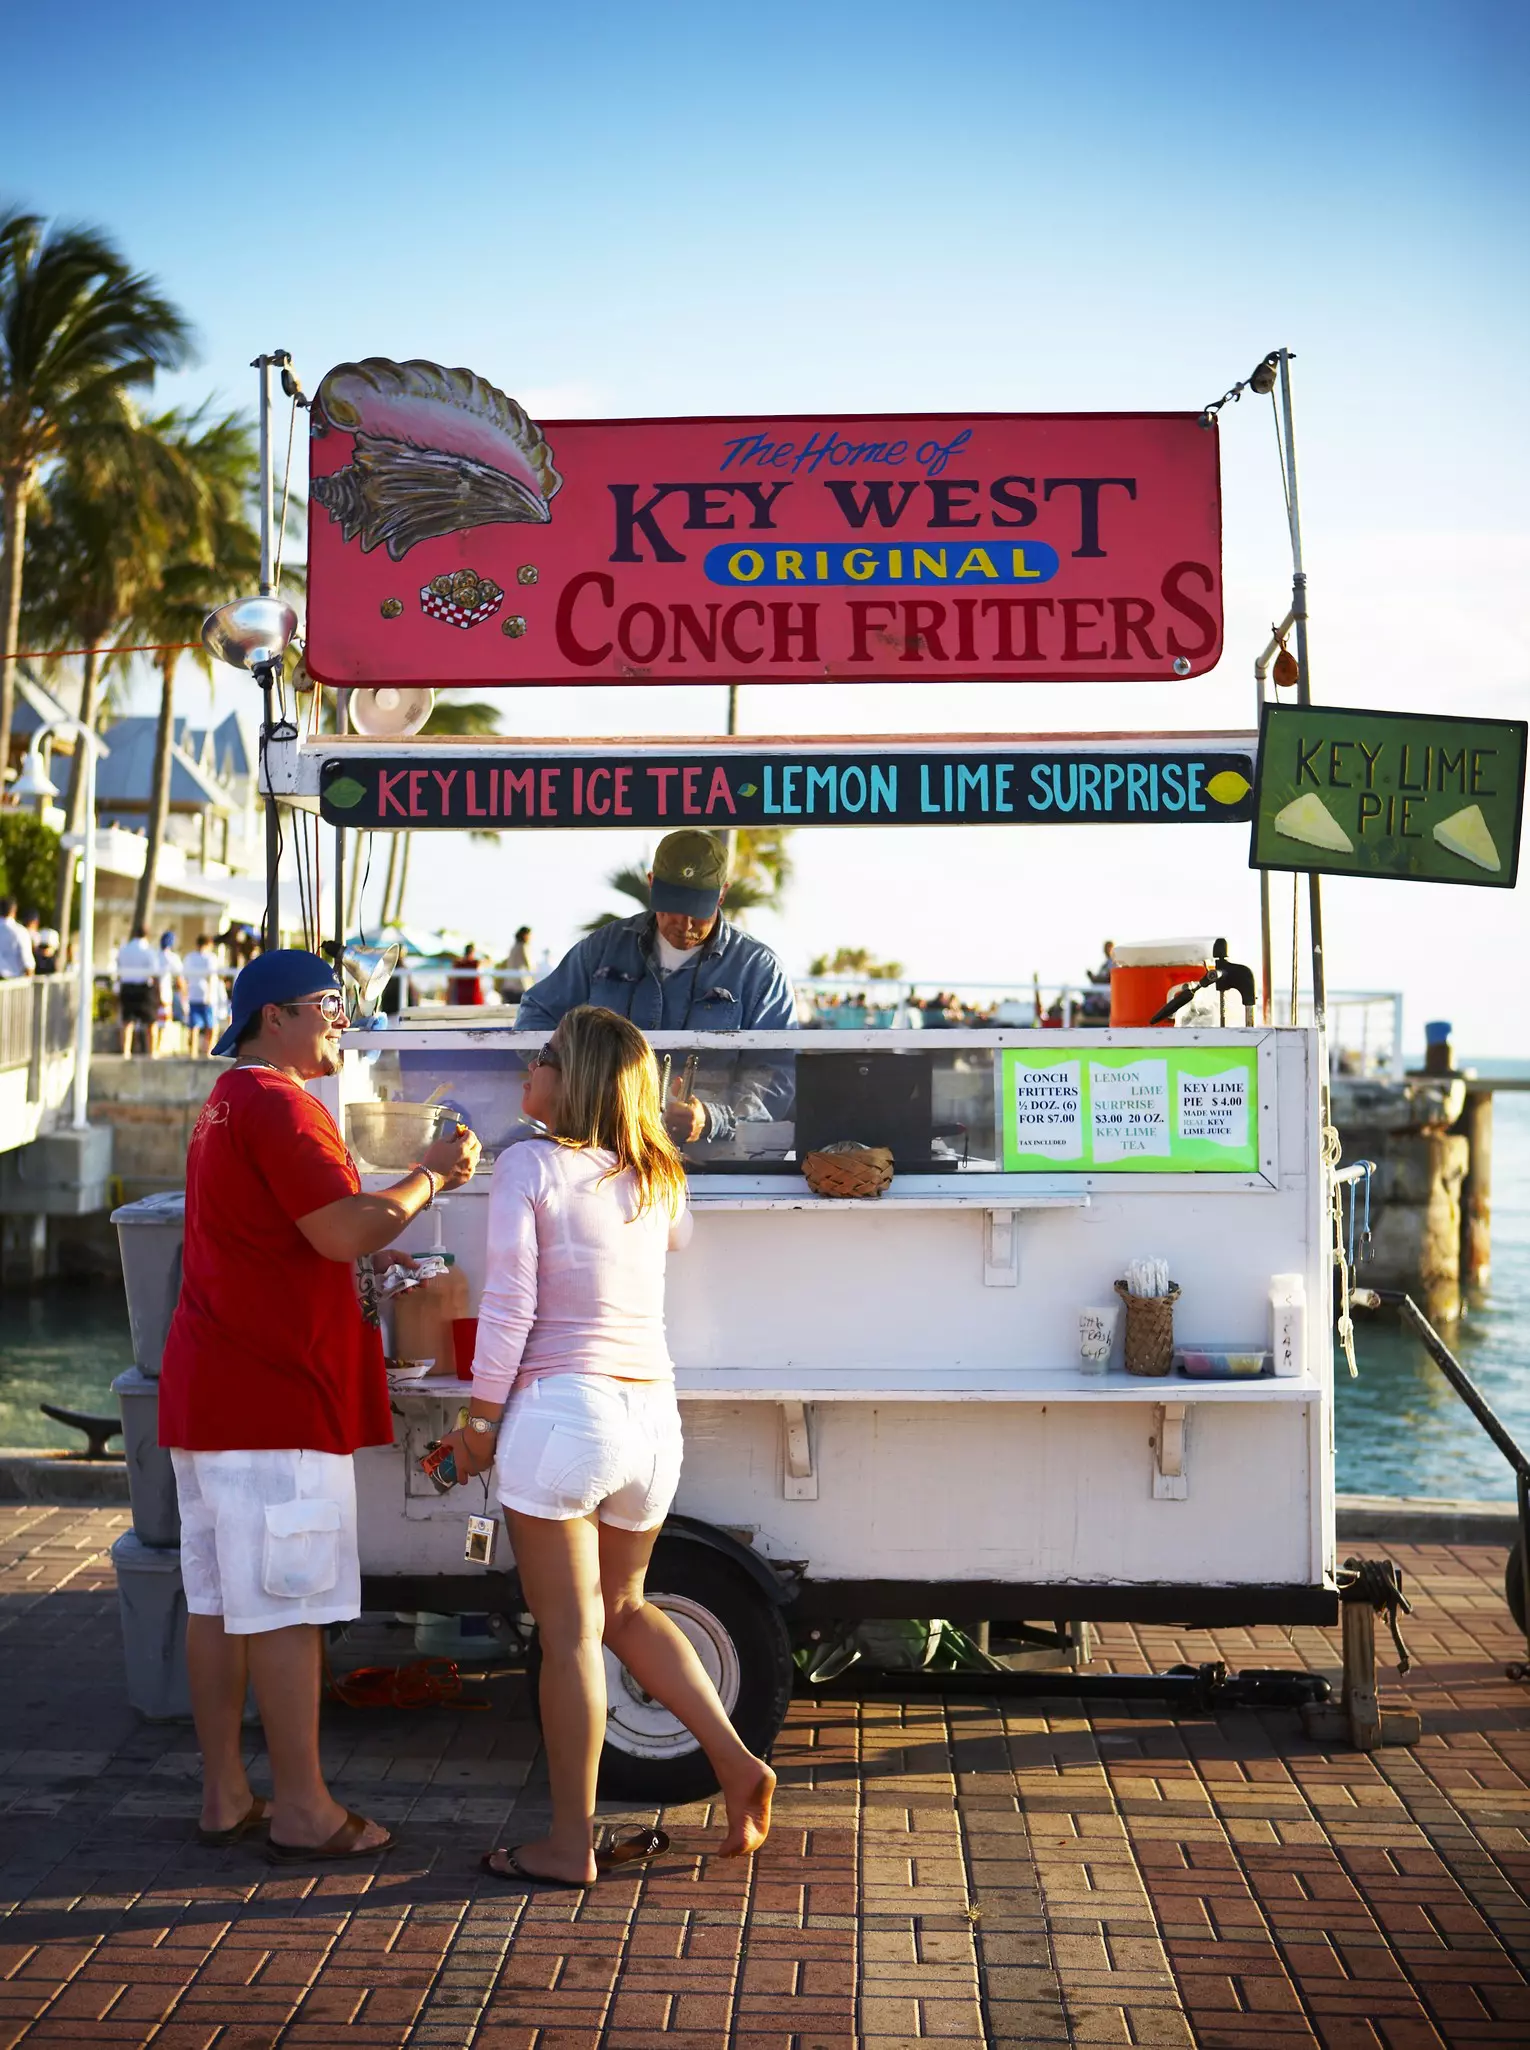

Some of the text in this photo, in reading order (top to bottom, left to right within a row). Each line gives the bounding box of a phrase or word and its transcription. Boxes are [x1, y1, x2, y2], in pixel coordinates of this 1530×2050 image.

[720, 429, 973, 476] The Home of
[606, 475, 1137, 563] KEY WEST
[727, 547, 1041, 582] ORIGINAL
[556, 561, 1216, 667] CONCH FRITTERS
[1296, 738, 1500, 797] KEY LIME
[378, 763, 1206, 817] KEY LIME ICE TEA LEMON LIME SURPRISE
[1358, 792, 1428, 838] PIE
[1023, 1073, 1068, 1083] CONCH
[1094, 1072, 1140, 1083] LEMON
[1018, 1087, 1078, 1097] FRITTERS
[1131, 1086, 1163, 1096] LIME
[1183, 1083, 1244, 1093] KEY LIME
[1031, 1100, 1060, 1110] DOZ.
[1062, 1100, 1077, 1111] (6)
[1095, 1100, 1155, 1110] SURPRISE
[1183, 1097, 1203, 1106] PIE
[1019, 1113, 1075, 1124] FOR $7.00
[1095, 1113, 1164, 1124] $3.00 20 OZ.
[1096, 1127, 1157, 1137] KEY LIME
[1120, 1140, 1146, 1150] TEA
